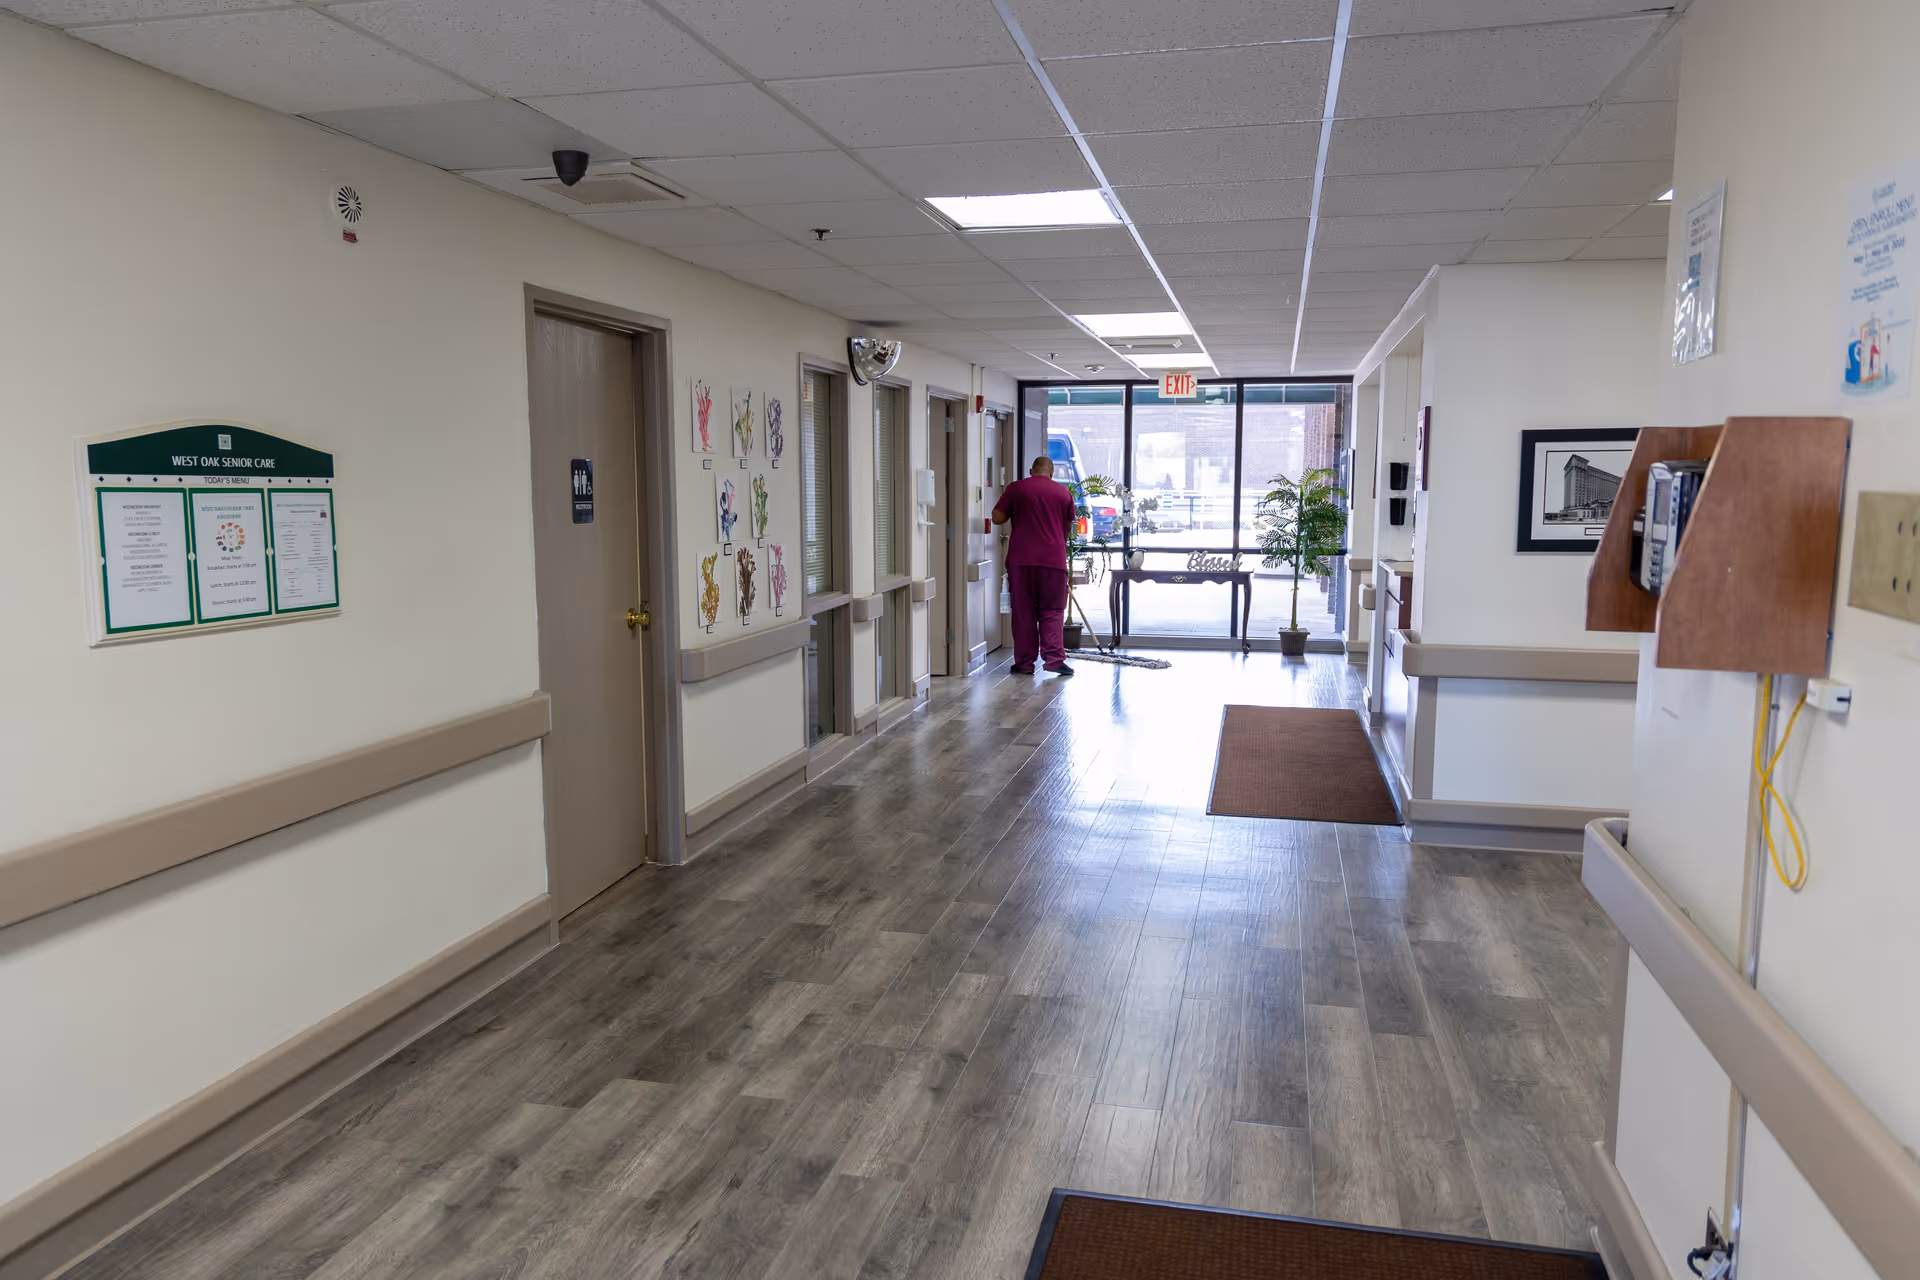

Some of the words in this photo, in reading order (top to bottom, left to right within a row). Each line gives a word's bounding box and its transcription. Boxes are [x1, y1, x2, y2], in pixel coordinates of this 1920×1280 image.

[1166, 375, 1192, 395] EXIT
[171, 455, 199, 466] WEST
[200, 456, 220, 467] OAK
[221, 457, 253, 468] SENIOR
[254, 458, 276, 469] CARE
[204, 476, 230, 484] TODAY'S
[231, 477, 250, 485] MENU
[1187, 550, 1243, 571] Blessed
